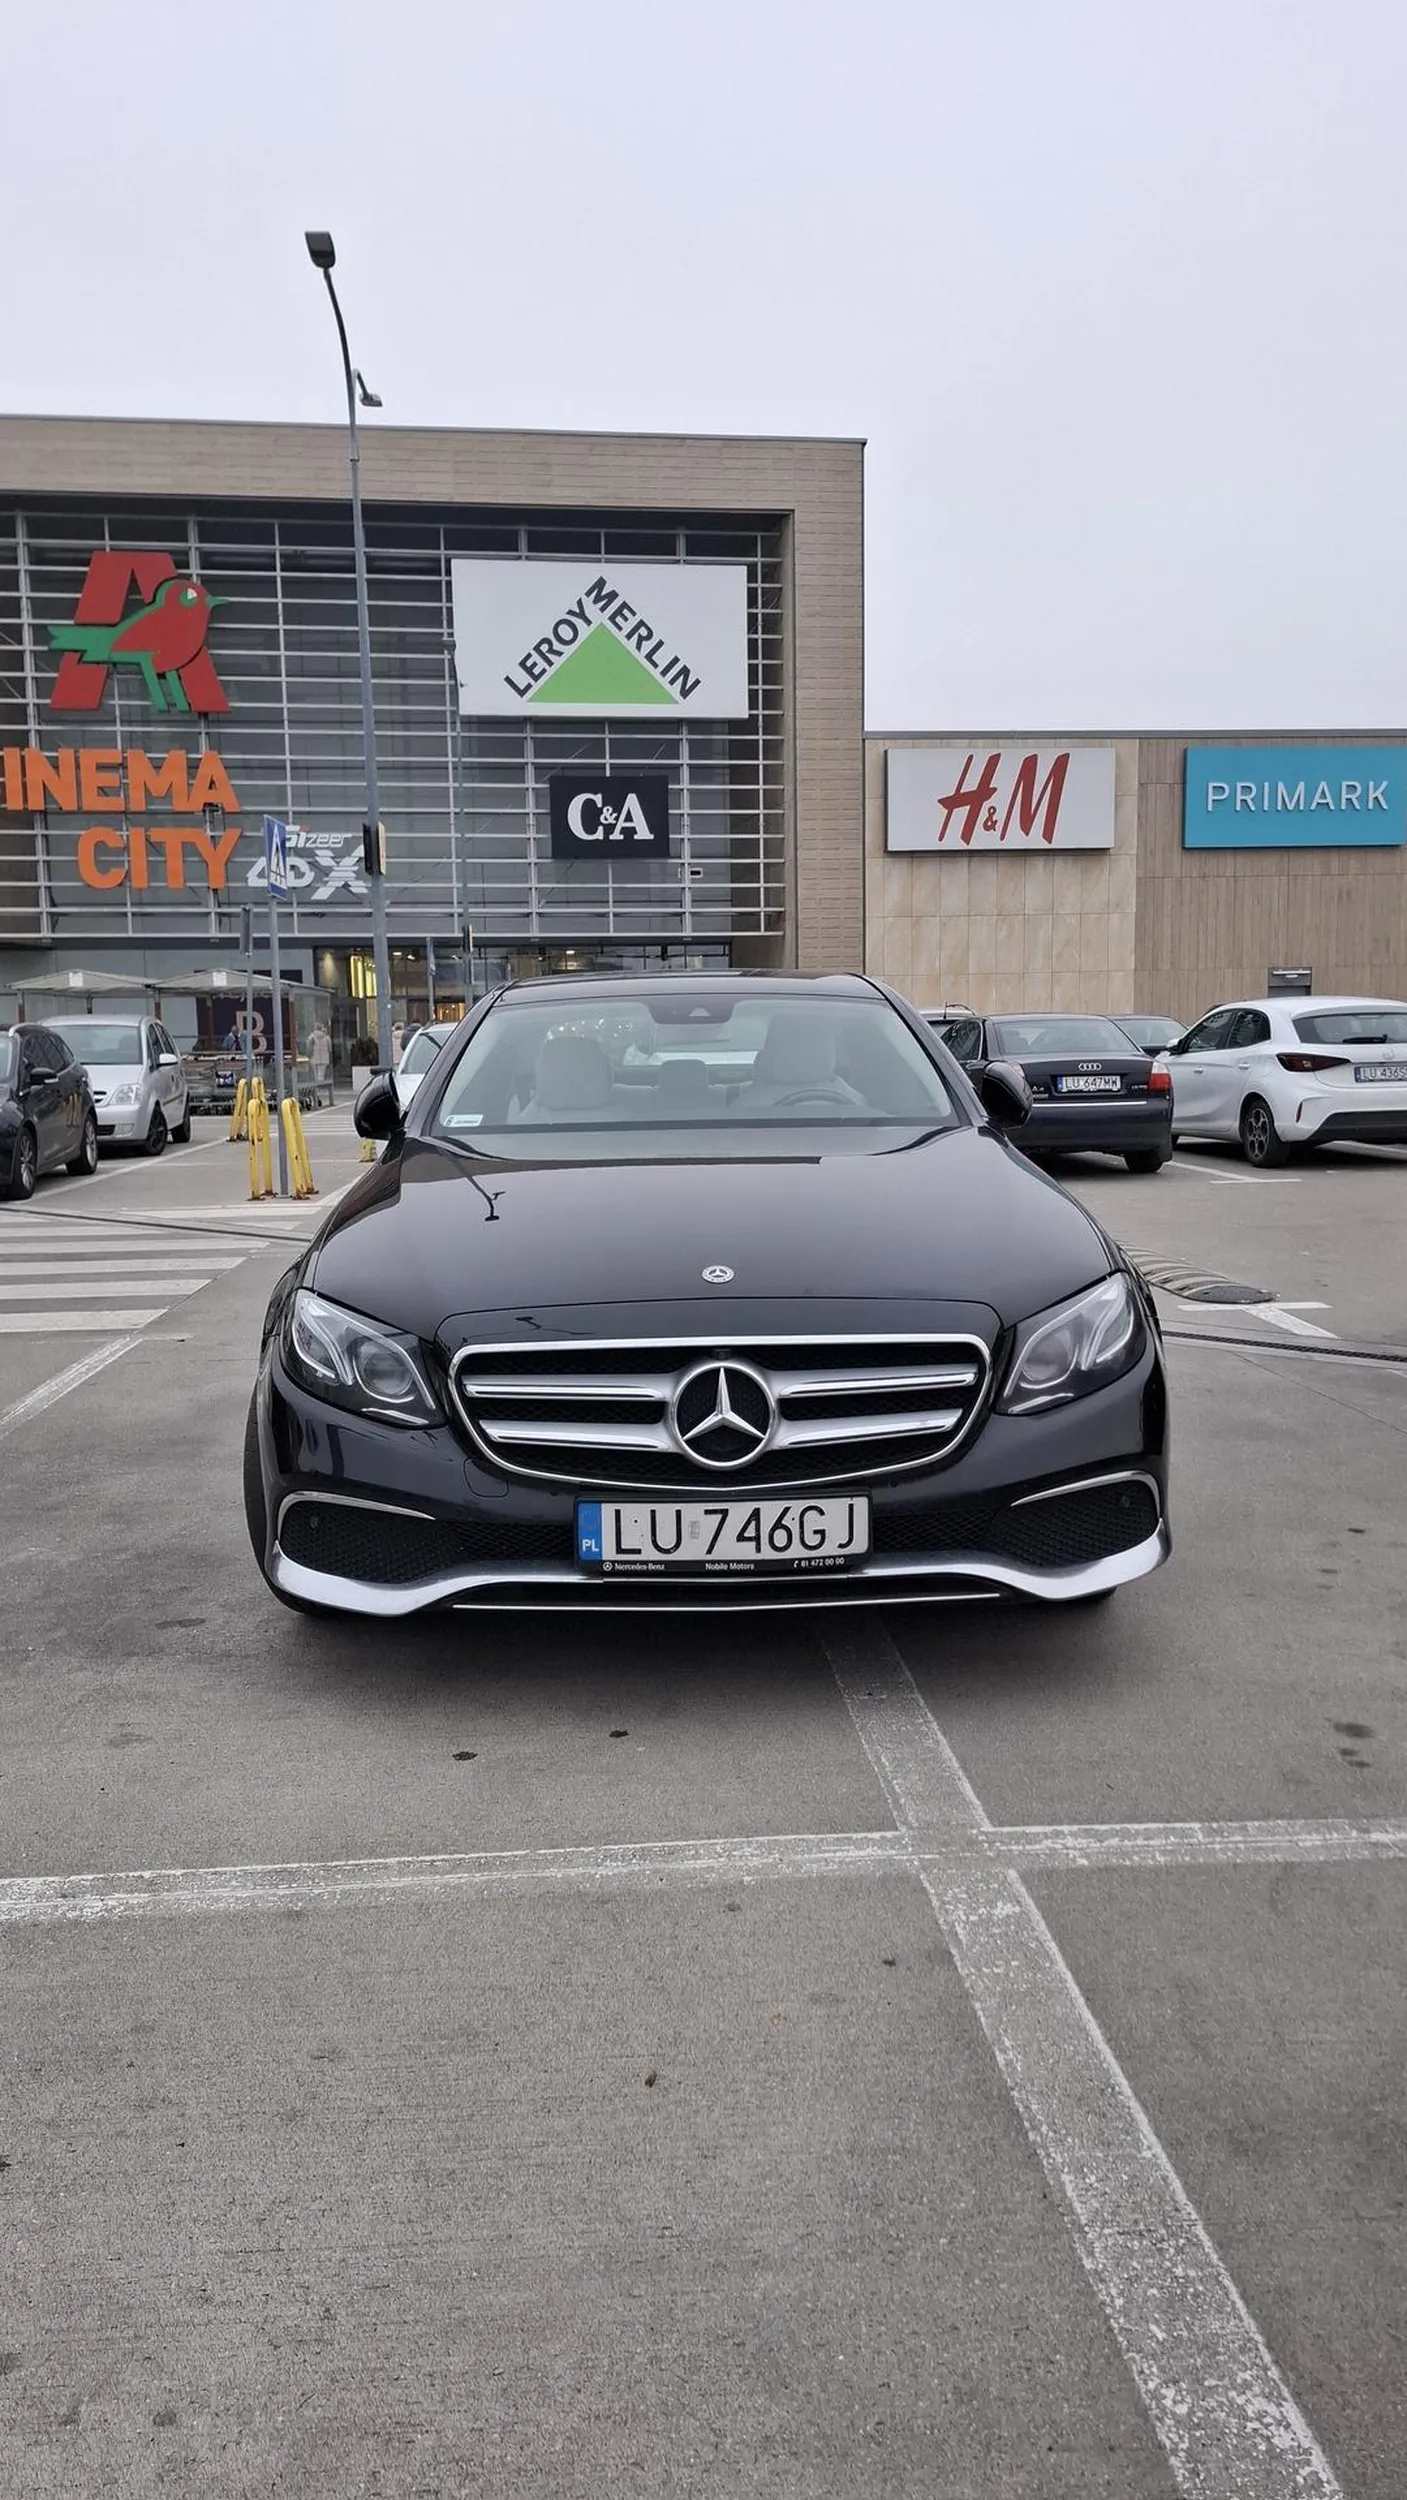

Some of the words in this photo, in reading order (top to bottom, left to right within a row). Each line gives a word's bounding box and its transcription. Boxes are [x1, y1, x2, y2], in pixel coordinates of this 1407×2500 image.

[504, 597, 592, 698] LEROY
[584, 575, 702, 700] MERLIN
[3, 747, 241, 812] INEMA
[937, 752, 1070, 846] H&M
[1207, 780, 1389, 812] PRIMARK
[567, 792, 655, 840] C&A
[77, 826, 242, 889] CITY
[1065, 1077, 1080, 1089] LU
[1380, 1066, 1407, 1078] 436S
[582, 1539, 600, 1552] PL
[614, 1508, 682, 1555] LU
[703, 1503, 855, 1556] 746GJ
[614, 1562, 665, 1571] Mercedes-Benz
